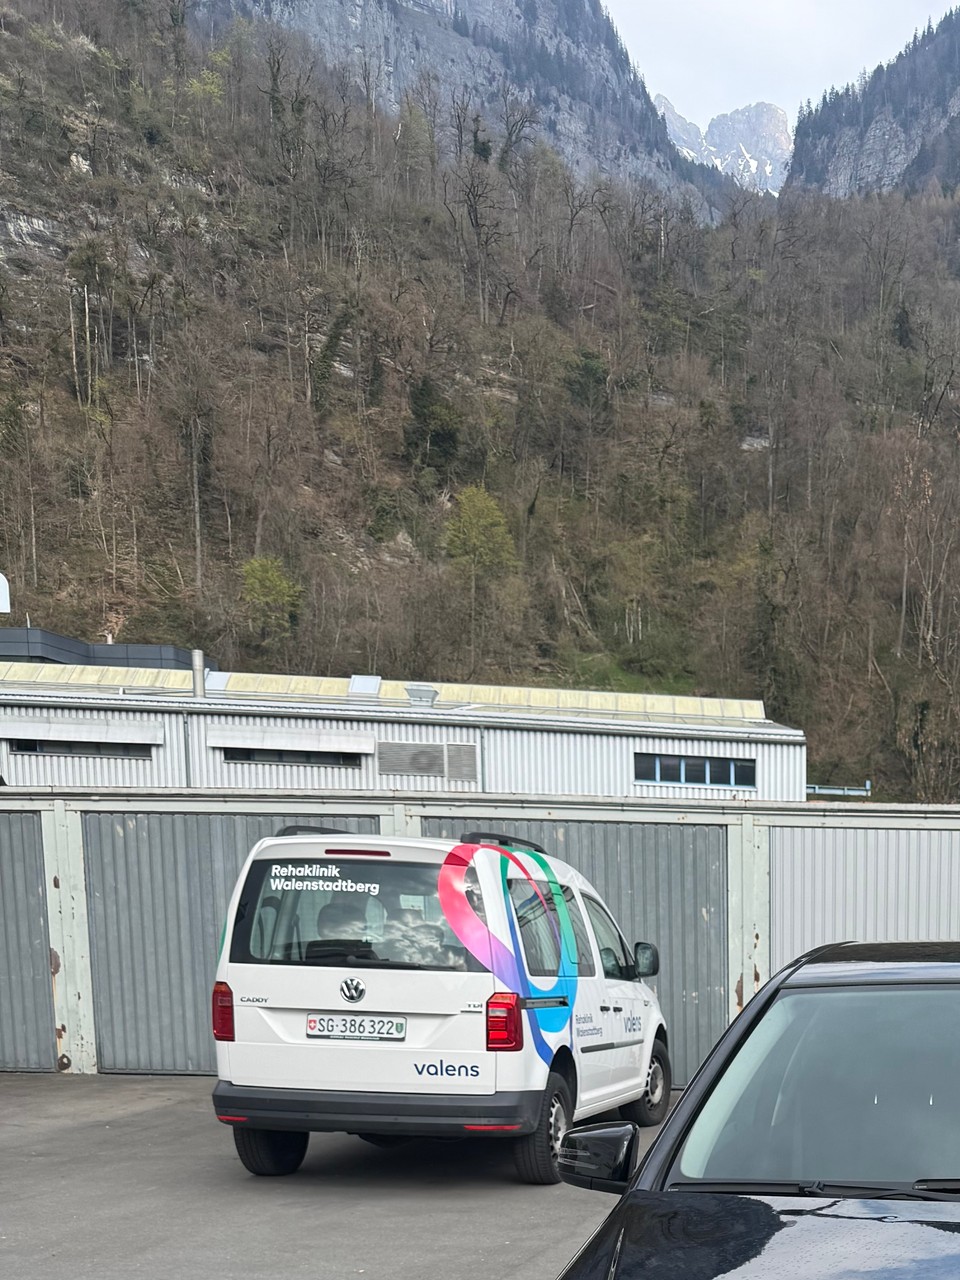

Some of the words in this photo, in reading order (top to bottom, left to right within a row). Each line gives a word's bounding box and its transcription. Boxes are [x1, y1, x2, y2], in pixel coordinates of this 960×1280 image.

[271, 864, 340, 877] Rehaklinik
[270, 878, 379, 895] Walenstadtberg
[414, 1059, 480, 1077] valens
